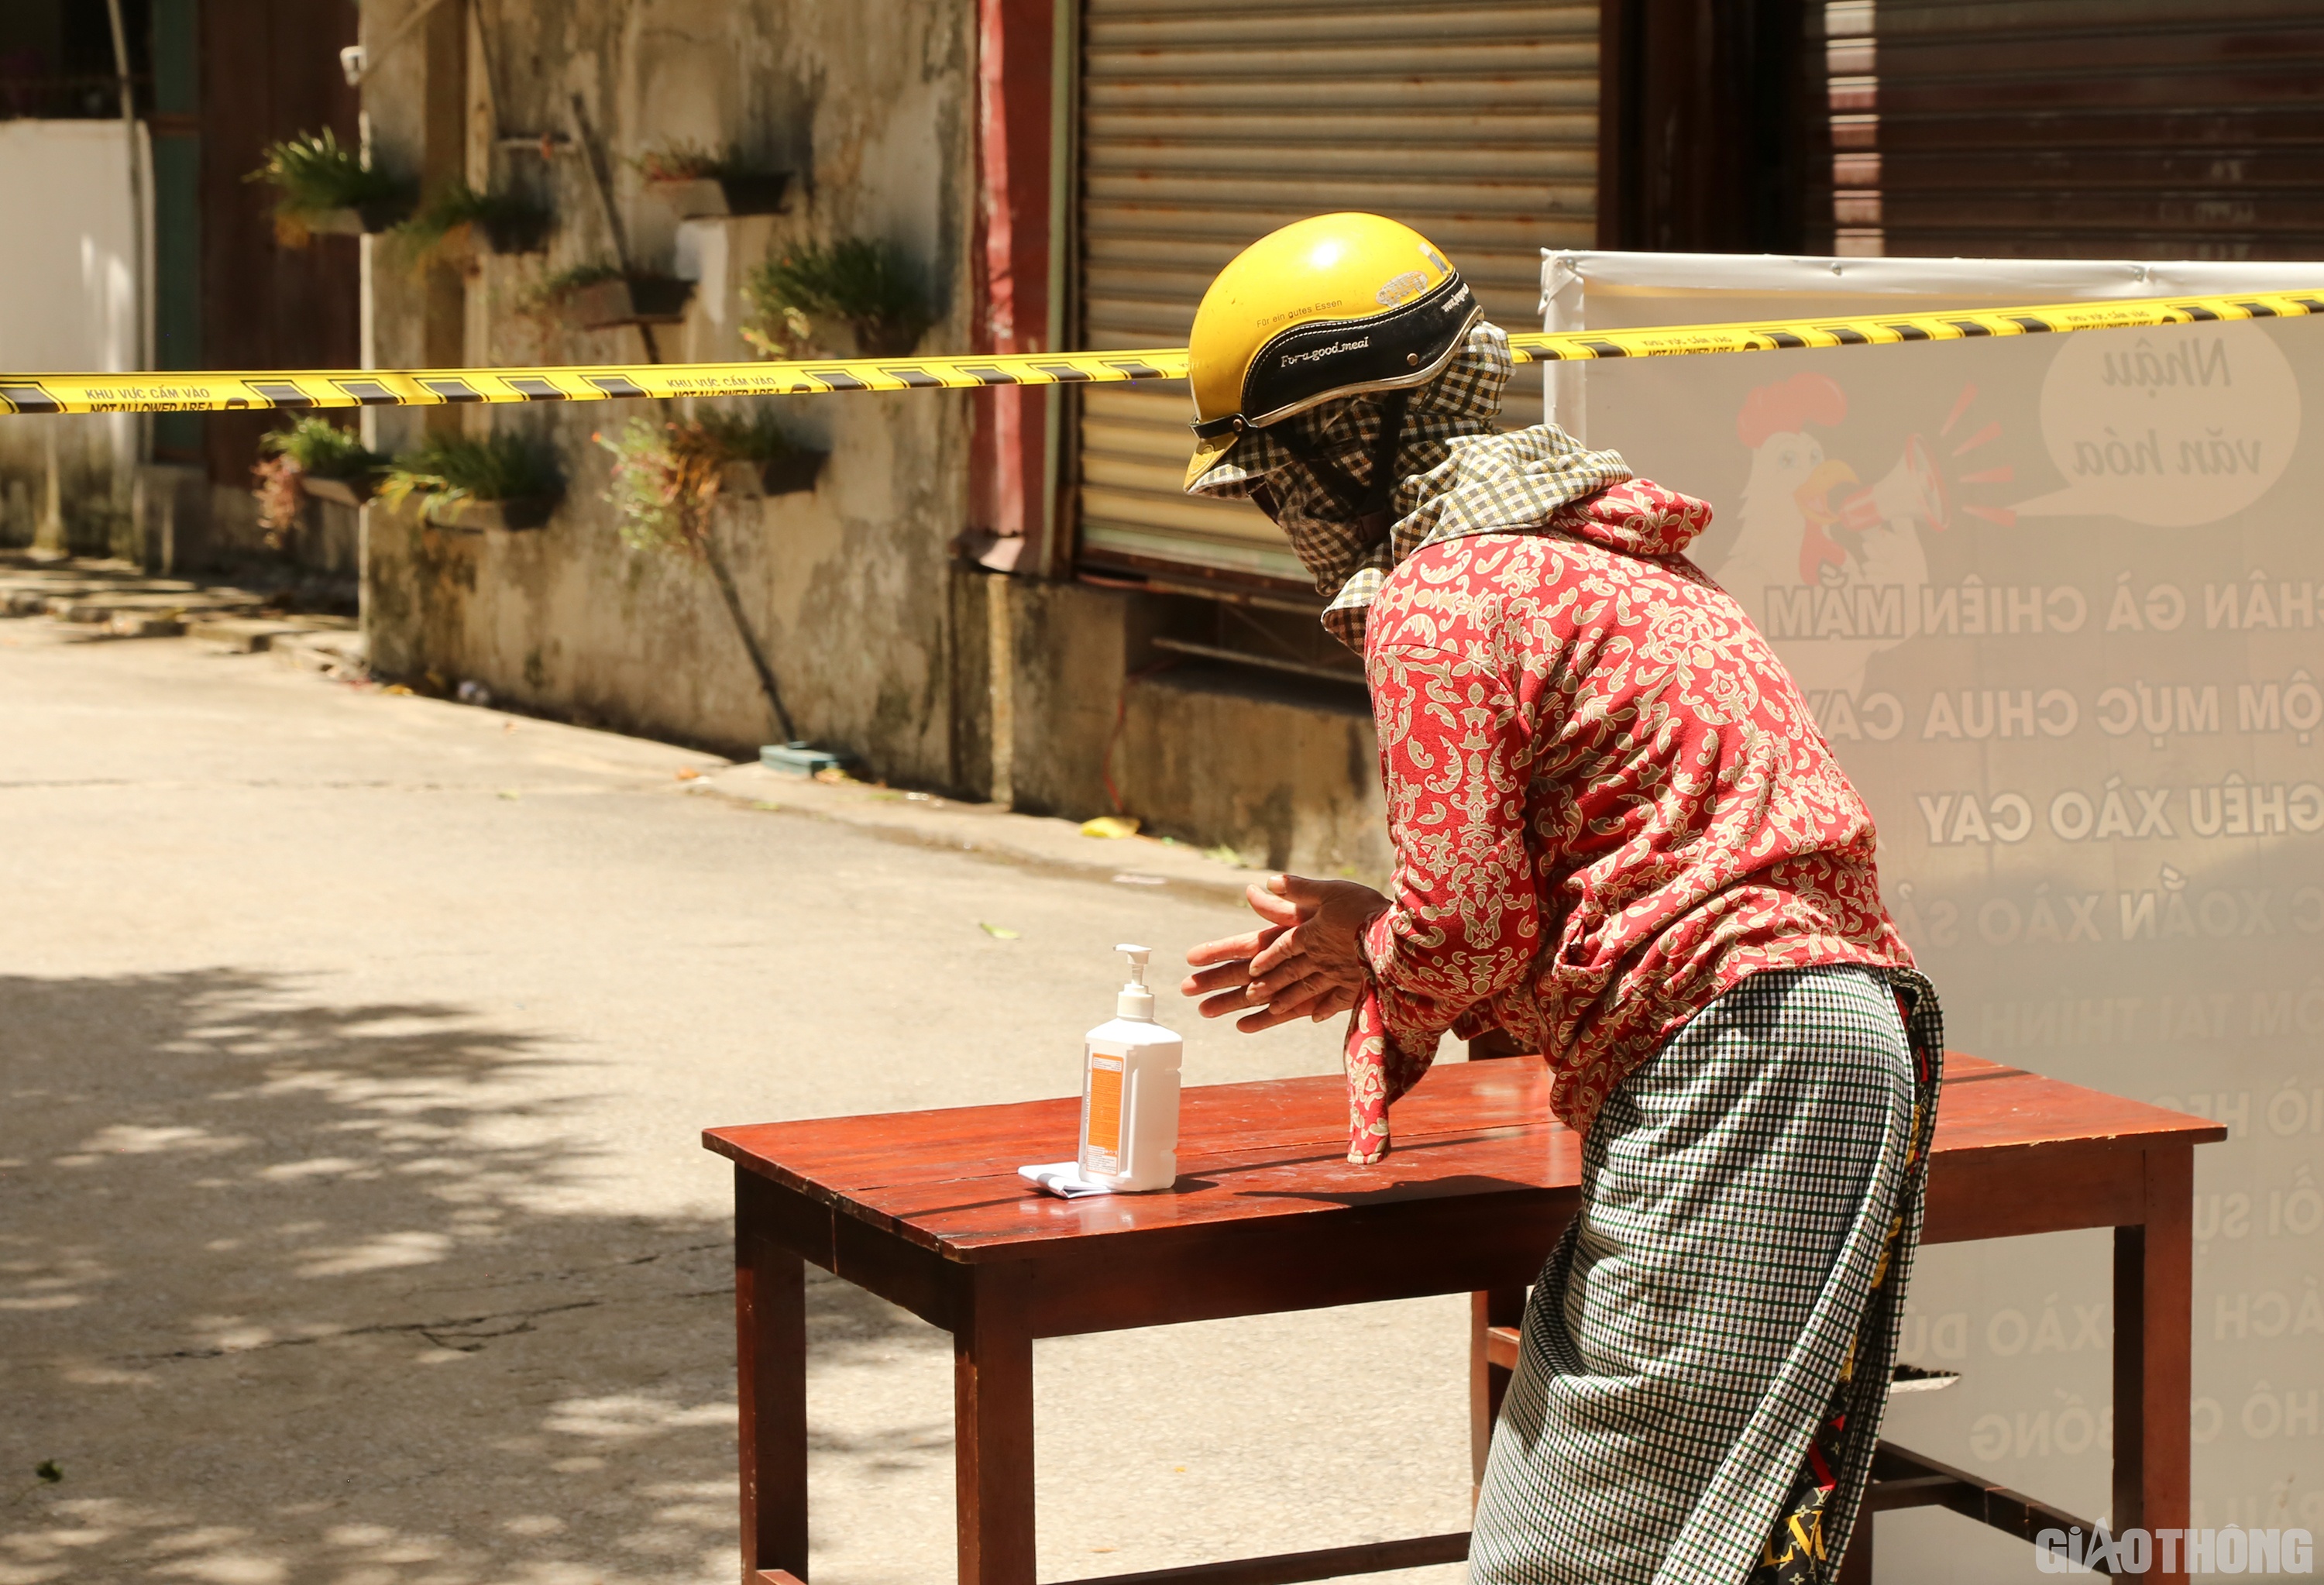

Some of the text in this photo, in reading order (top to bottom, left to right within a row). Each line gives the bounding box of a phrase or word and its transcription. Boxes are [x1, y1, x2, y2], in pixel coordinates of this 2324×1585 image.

[1257, 300, 1342, 328] Für ein gutes Essen
[666, 378, 693, 388] KHU
[84, 388, 115, 400] KHU
[181, 385, 211, 399] VÀO
